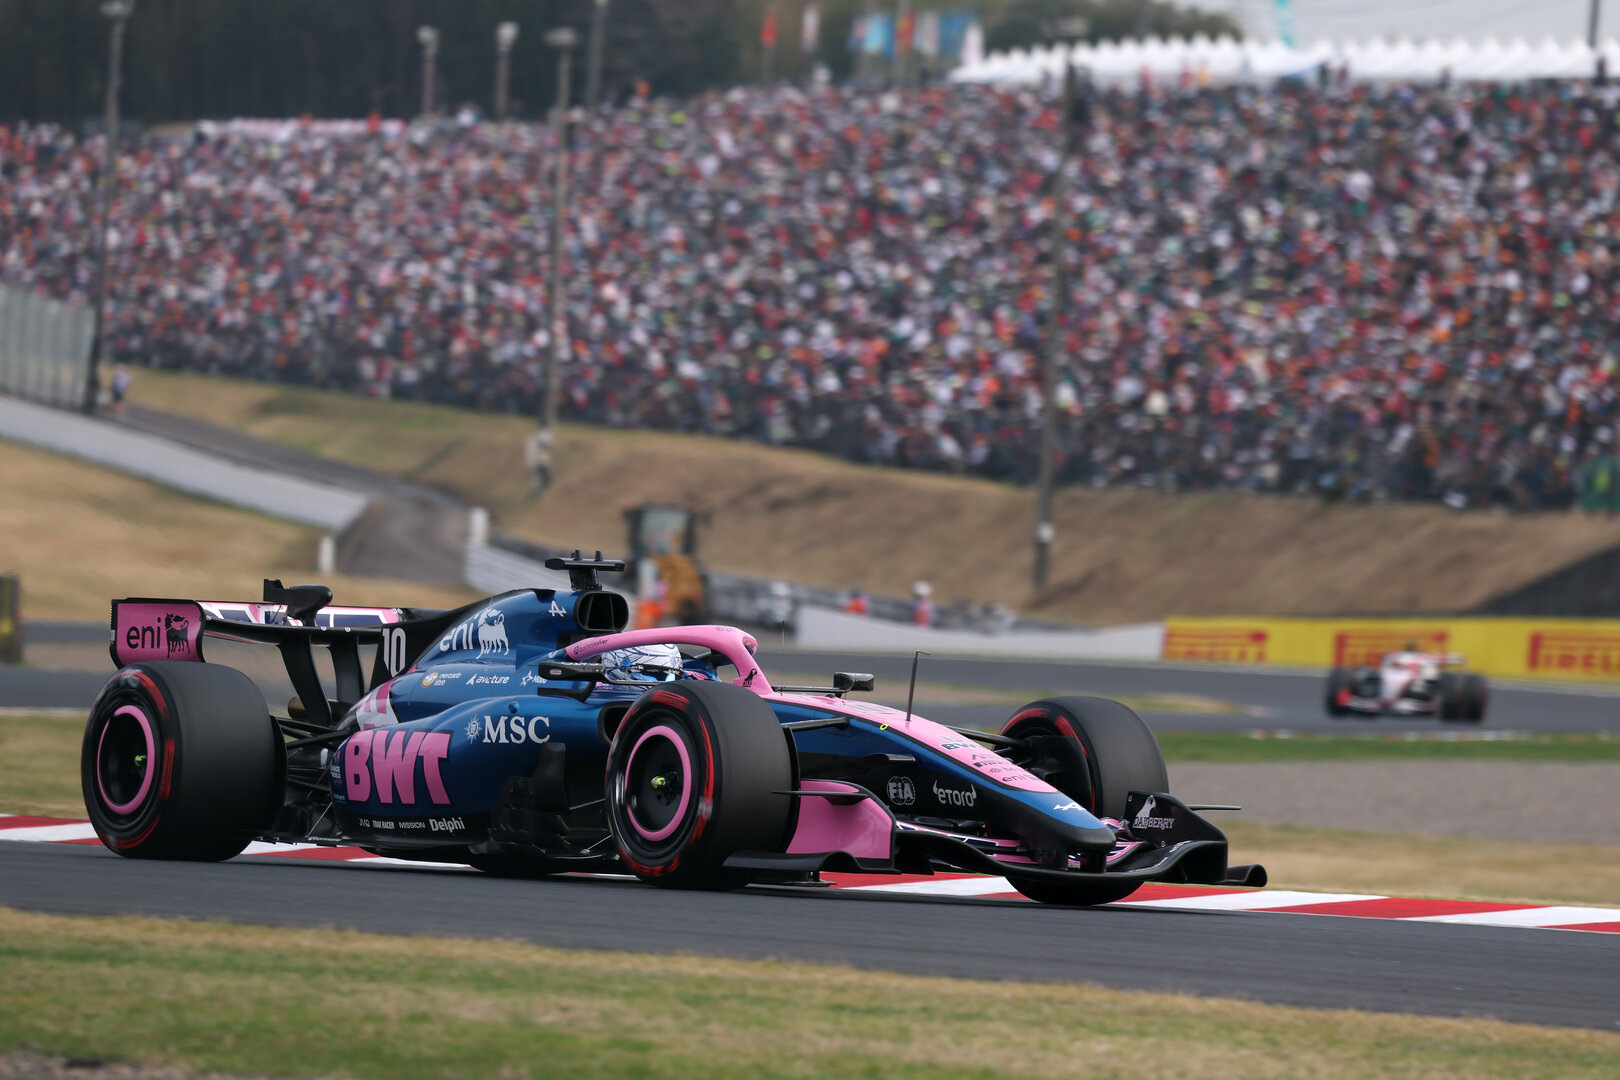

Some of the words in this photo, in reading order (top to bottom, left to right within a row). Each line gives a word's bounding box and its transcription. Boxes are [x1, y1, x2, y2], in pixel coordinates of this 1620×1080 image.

[126, 618, 161, 649] eni
[439, 614, 480, 651] eni
[381, 628, 406, 678] 10
[483, 715, 551, 744] MSC
[344, 729, 453, 805] BWT
[399, 821, 426, 829] MISSION
[429, 817, 465, 832] Delphi
